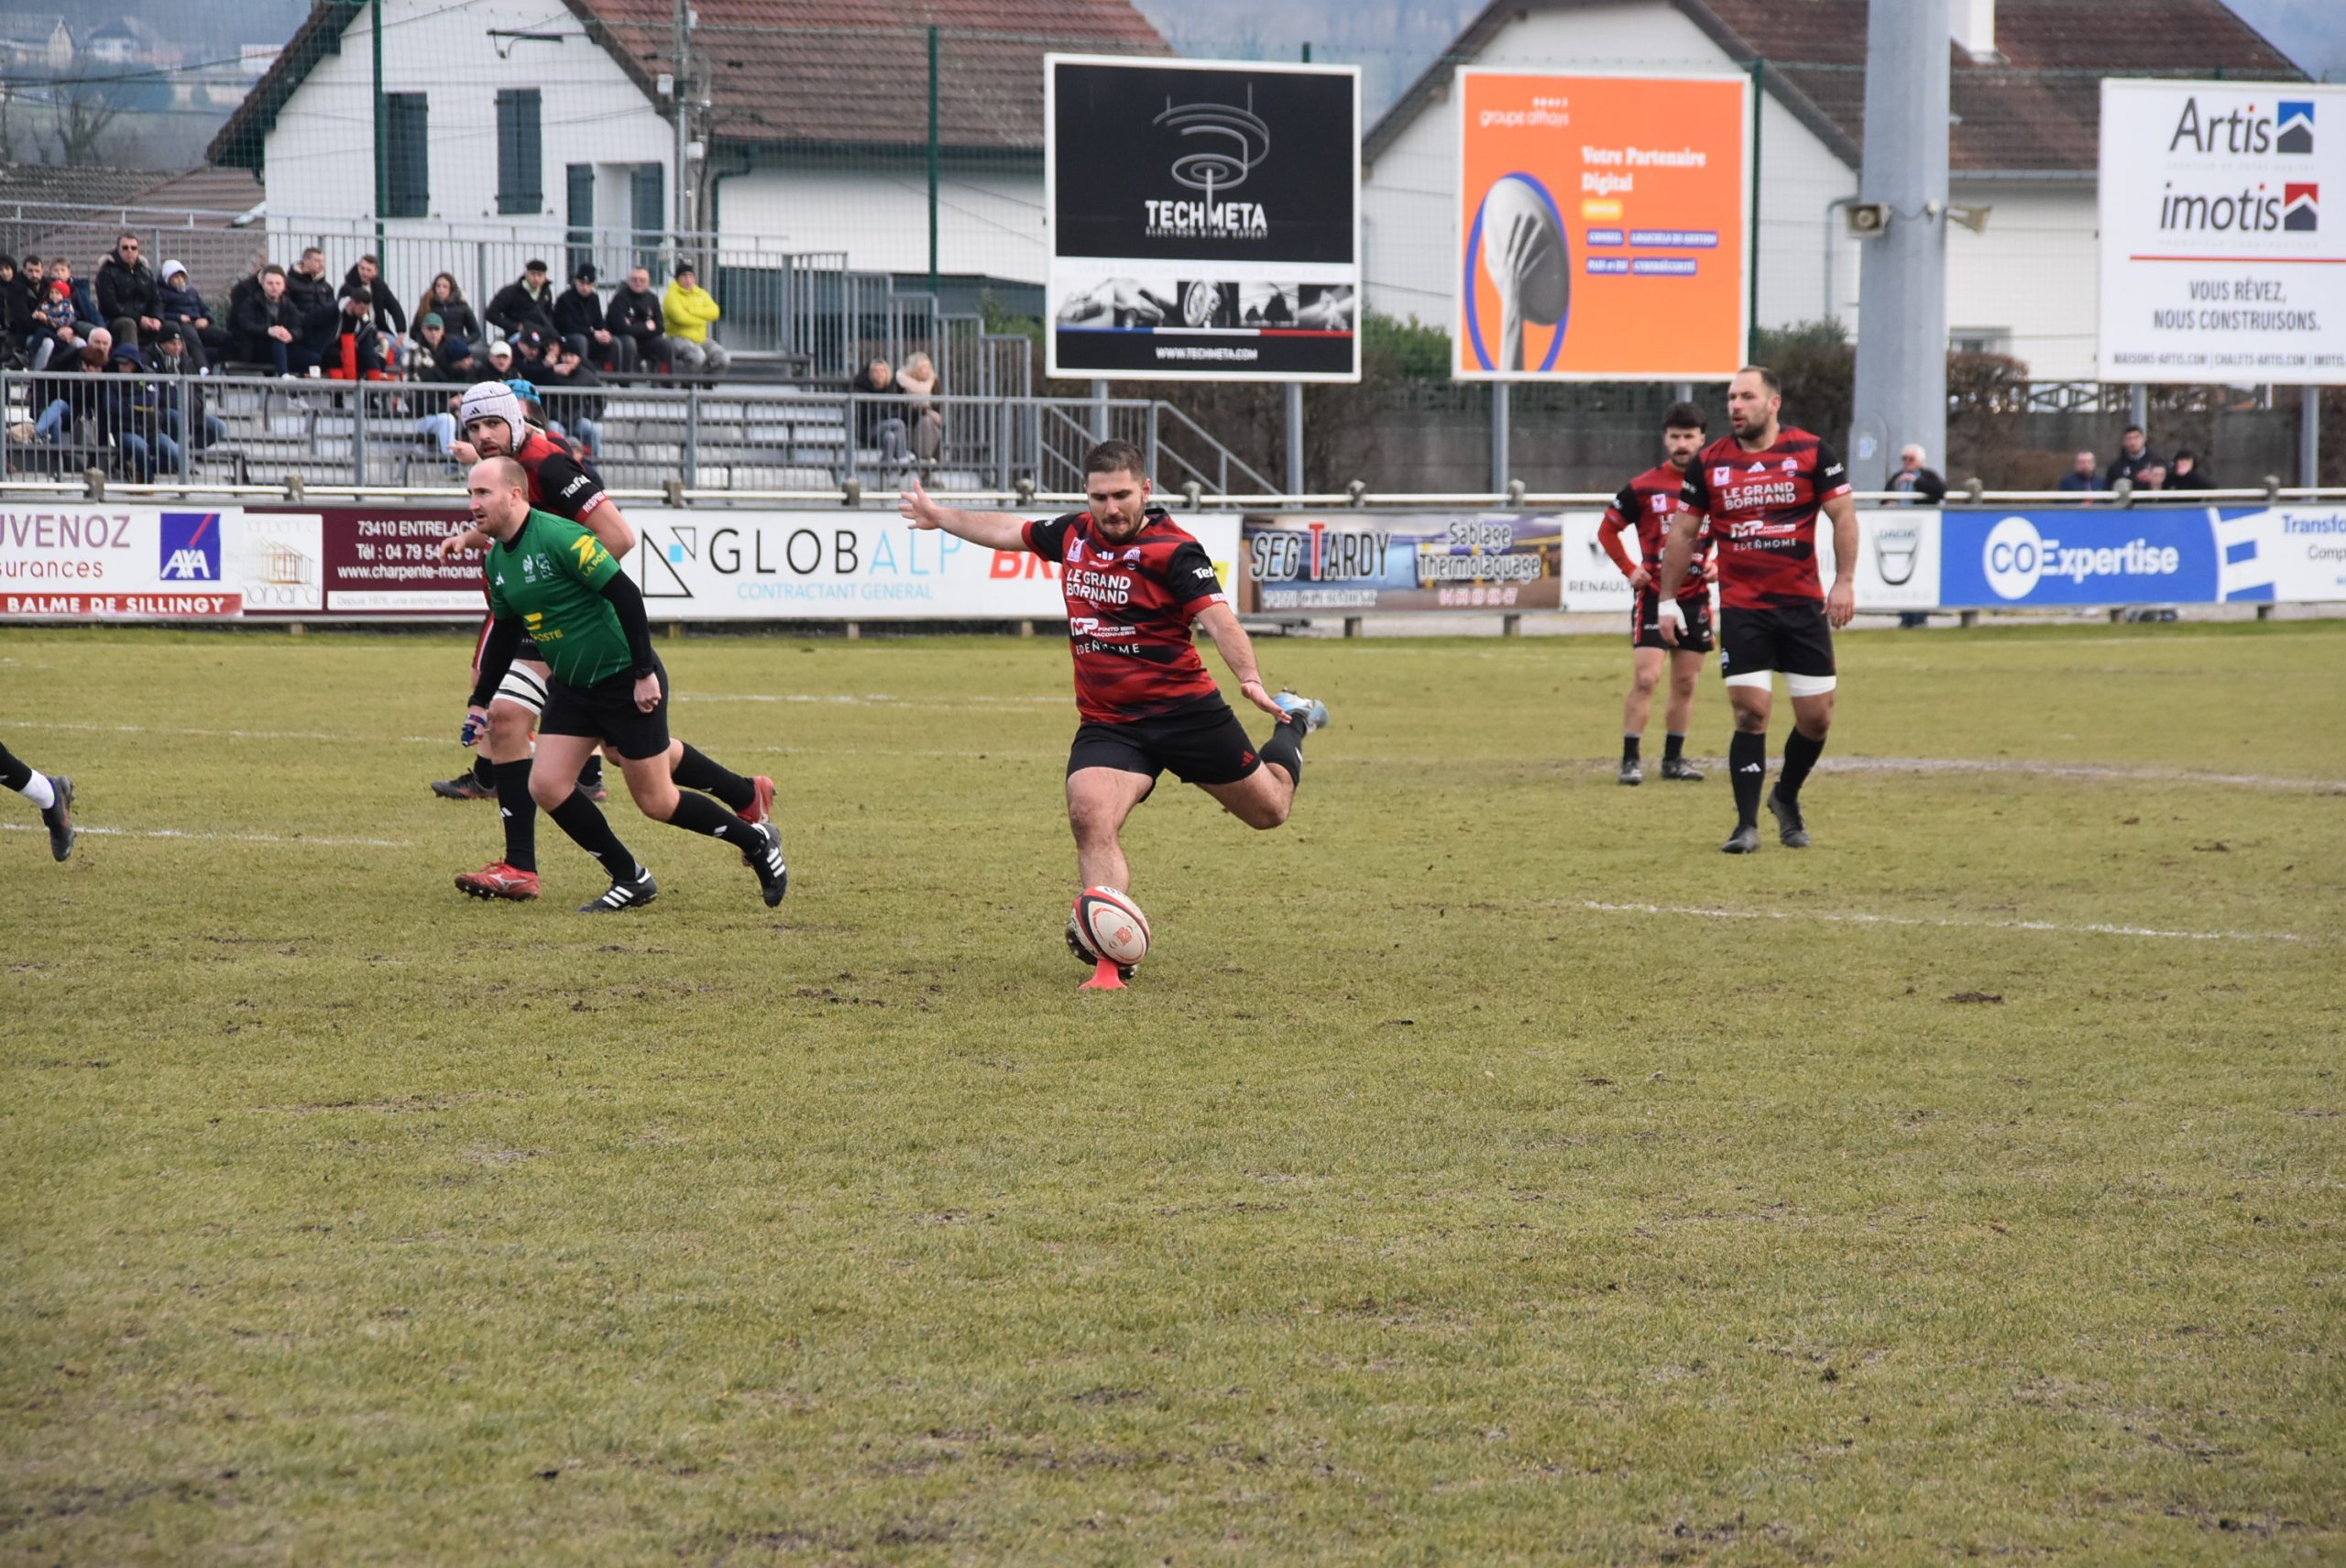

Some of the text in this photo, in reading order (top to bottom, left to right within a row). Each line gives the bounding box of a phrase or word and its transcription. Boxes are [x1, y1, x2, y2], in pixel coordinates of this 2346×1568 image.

[1480, 110, 1525, 127] groupe
[2169, 97, 2271, 154] Artis
[1581, 147, 1706, 167] Votre Partenaire
[1582, 171, 1633, 195] Digital
[1145, 200, 1268, 231] TECHMETA
[2160, 181, 2280, 232] imotis
[2189, 276, 2286, 304] VOUS RÊVEZ,
[2154, 310, 2321, 332] NOUS CONSTRUISONS.
[1723, 482, 1794, 500] LE GRAND
[1724, 493, 1796, 511] BORNAND
[0, 514, 131, 548] VENOZ
[357, 520, 397, 537] 73410
[1449, 520, 1512, 553] Sablage
[385, 543, 401, 560] 04
[405, 543, 422, 560] 79
[709, 528, 962, 575] GLOBALP
[1250, 522, 1392, 581] SEG TARDY
[0, 561, 103, 578] urances
[160, 549, 211, 578] AXA
[1418, 552, 1542, 584] Thermolaquage
[1067, 568, 1131, 590] LE GRAND
[1568, 580, 1632, 592] RENAUL
[738, 583, 933, 600] CONTRACTANT GENERAL
[1066, 582, 1129, 605] BORNAND
[7, 597, 225, 614] BALME DE SILLINGY
